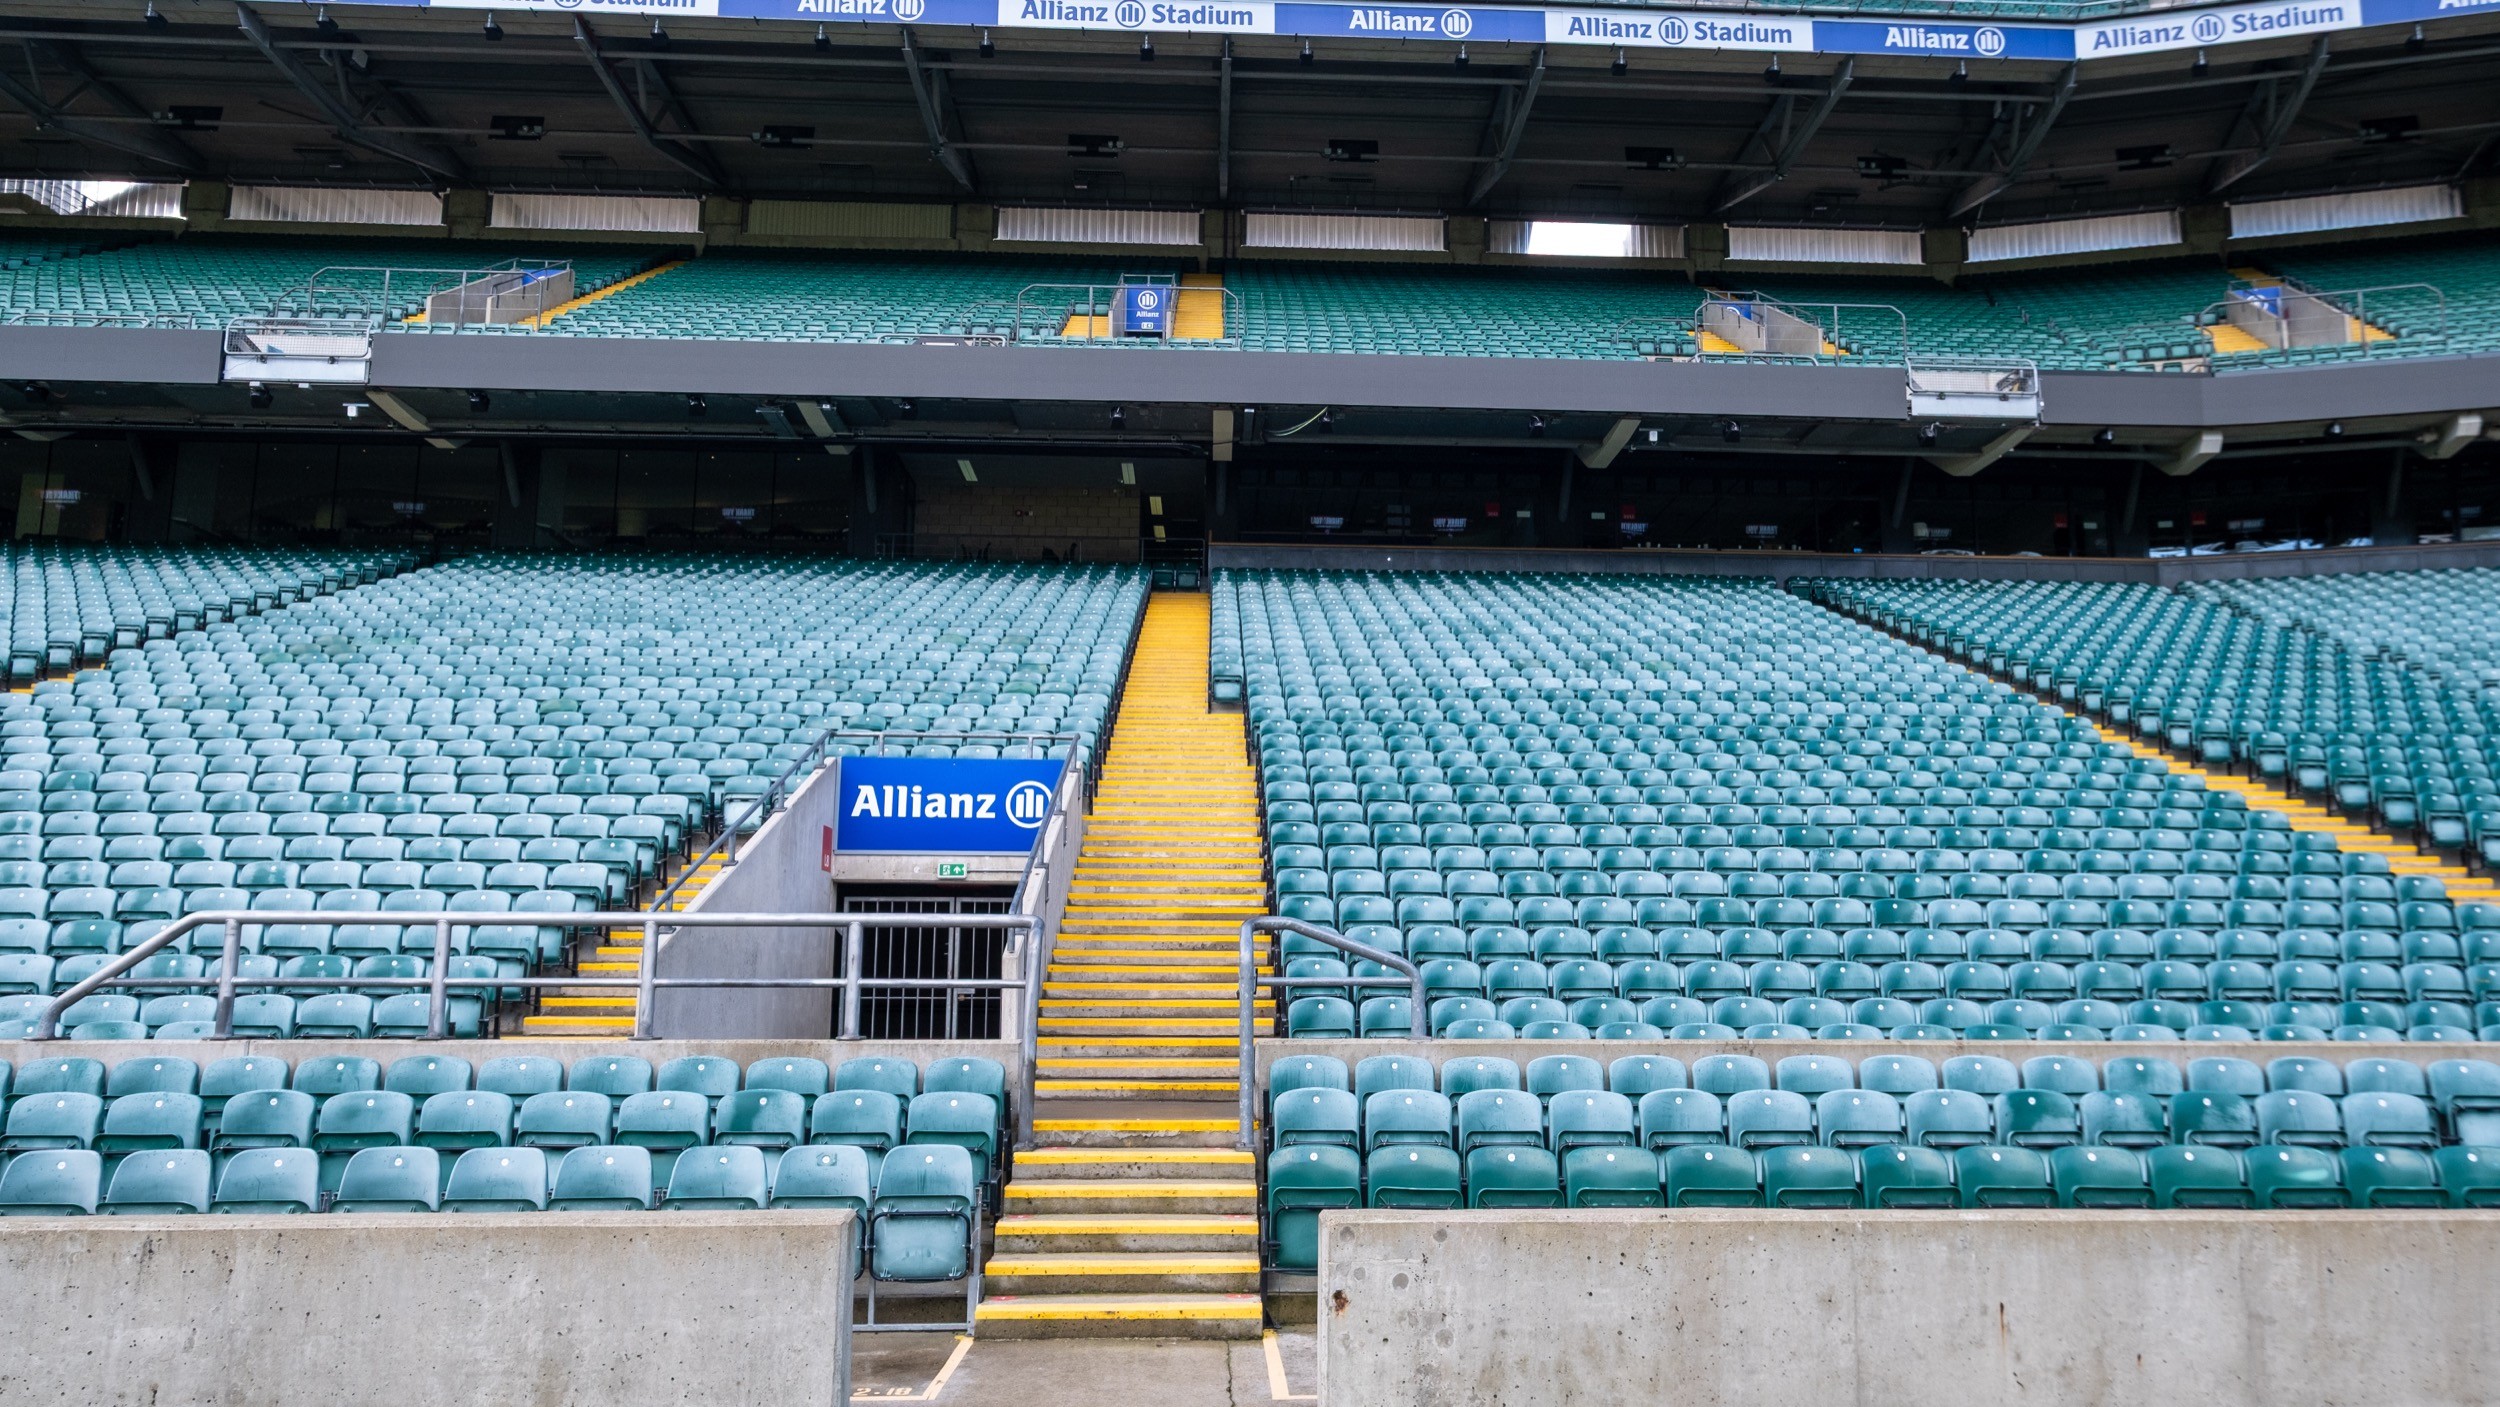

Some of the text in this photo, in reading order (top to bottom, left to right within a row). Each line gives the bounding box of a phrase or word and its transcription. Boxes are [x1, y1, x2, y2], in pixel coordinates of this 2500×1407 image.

[797, 0, 886, 14] Allianz
[1021, 0, 1253, 26] Allianz Stadium
[1349, 9, 1436, 32] Allianz
[1568, 16, 1792, 44] Allianz Stadium
[2093, 6, 2344, 50] Allianz Stadium
[1885, 27, 1969, 50] Allianz
[851, 785, 996, 819] Allianz
